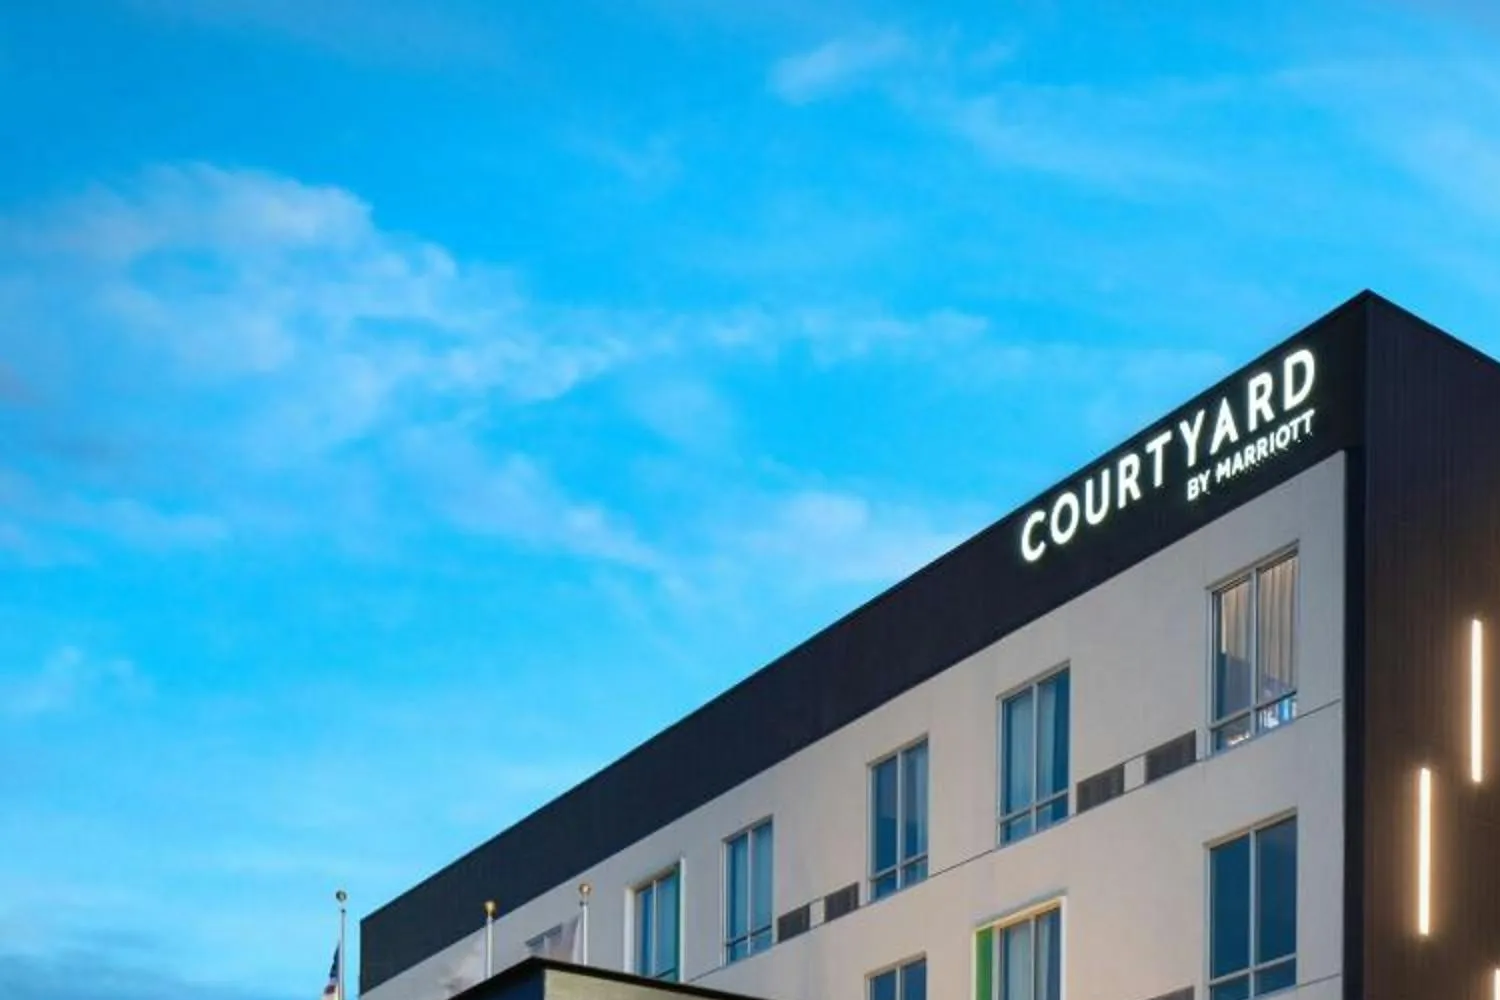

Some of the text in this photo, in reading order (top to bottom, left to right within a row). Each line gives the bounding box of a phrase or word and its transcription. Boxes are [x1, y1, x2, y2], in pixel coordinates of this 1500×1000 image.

[1021, 349, 1316, 562] COURTYARD
[1187, 409, 1315, 501] BY MARRIOTT
